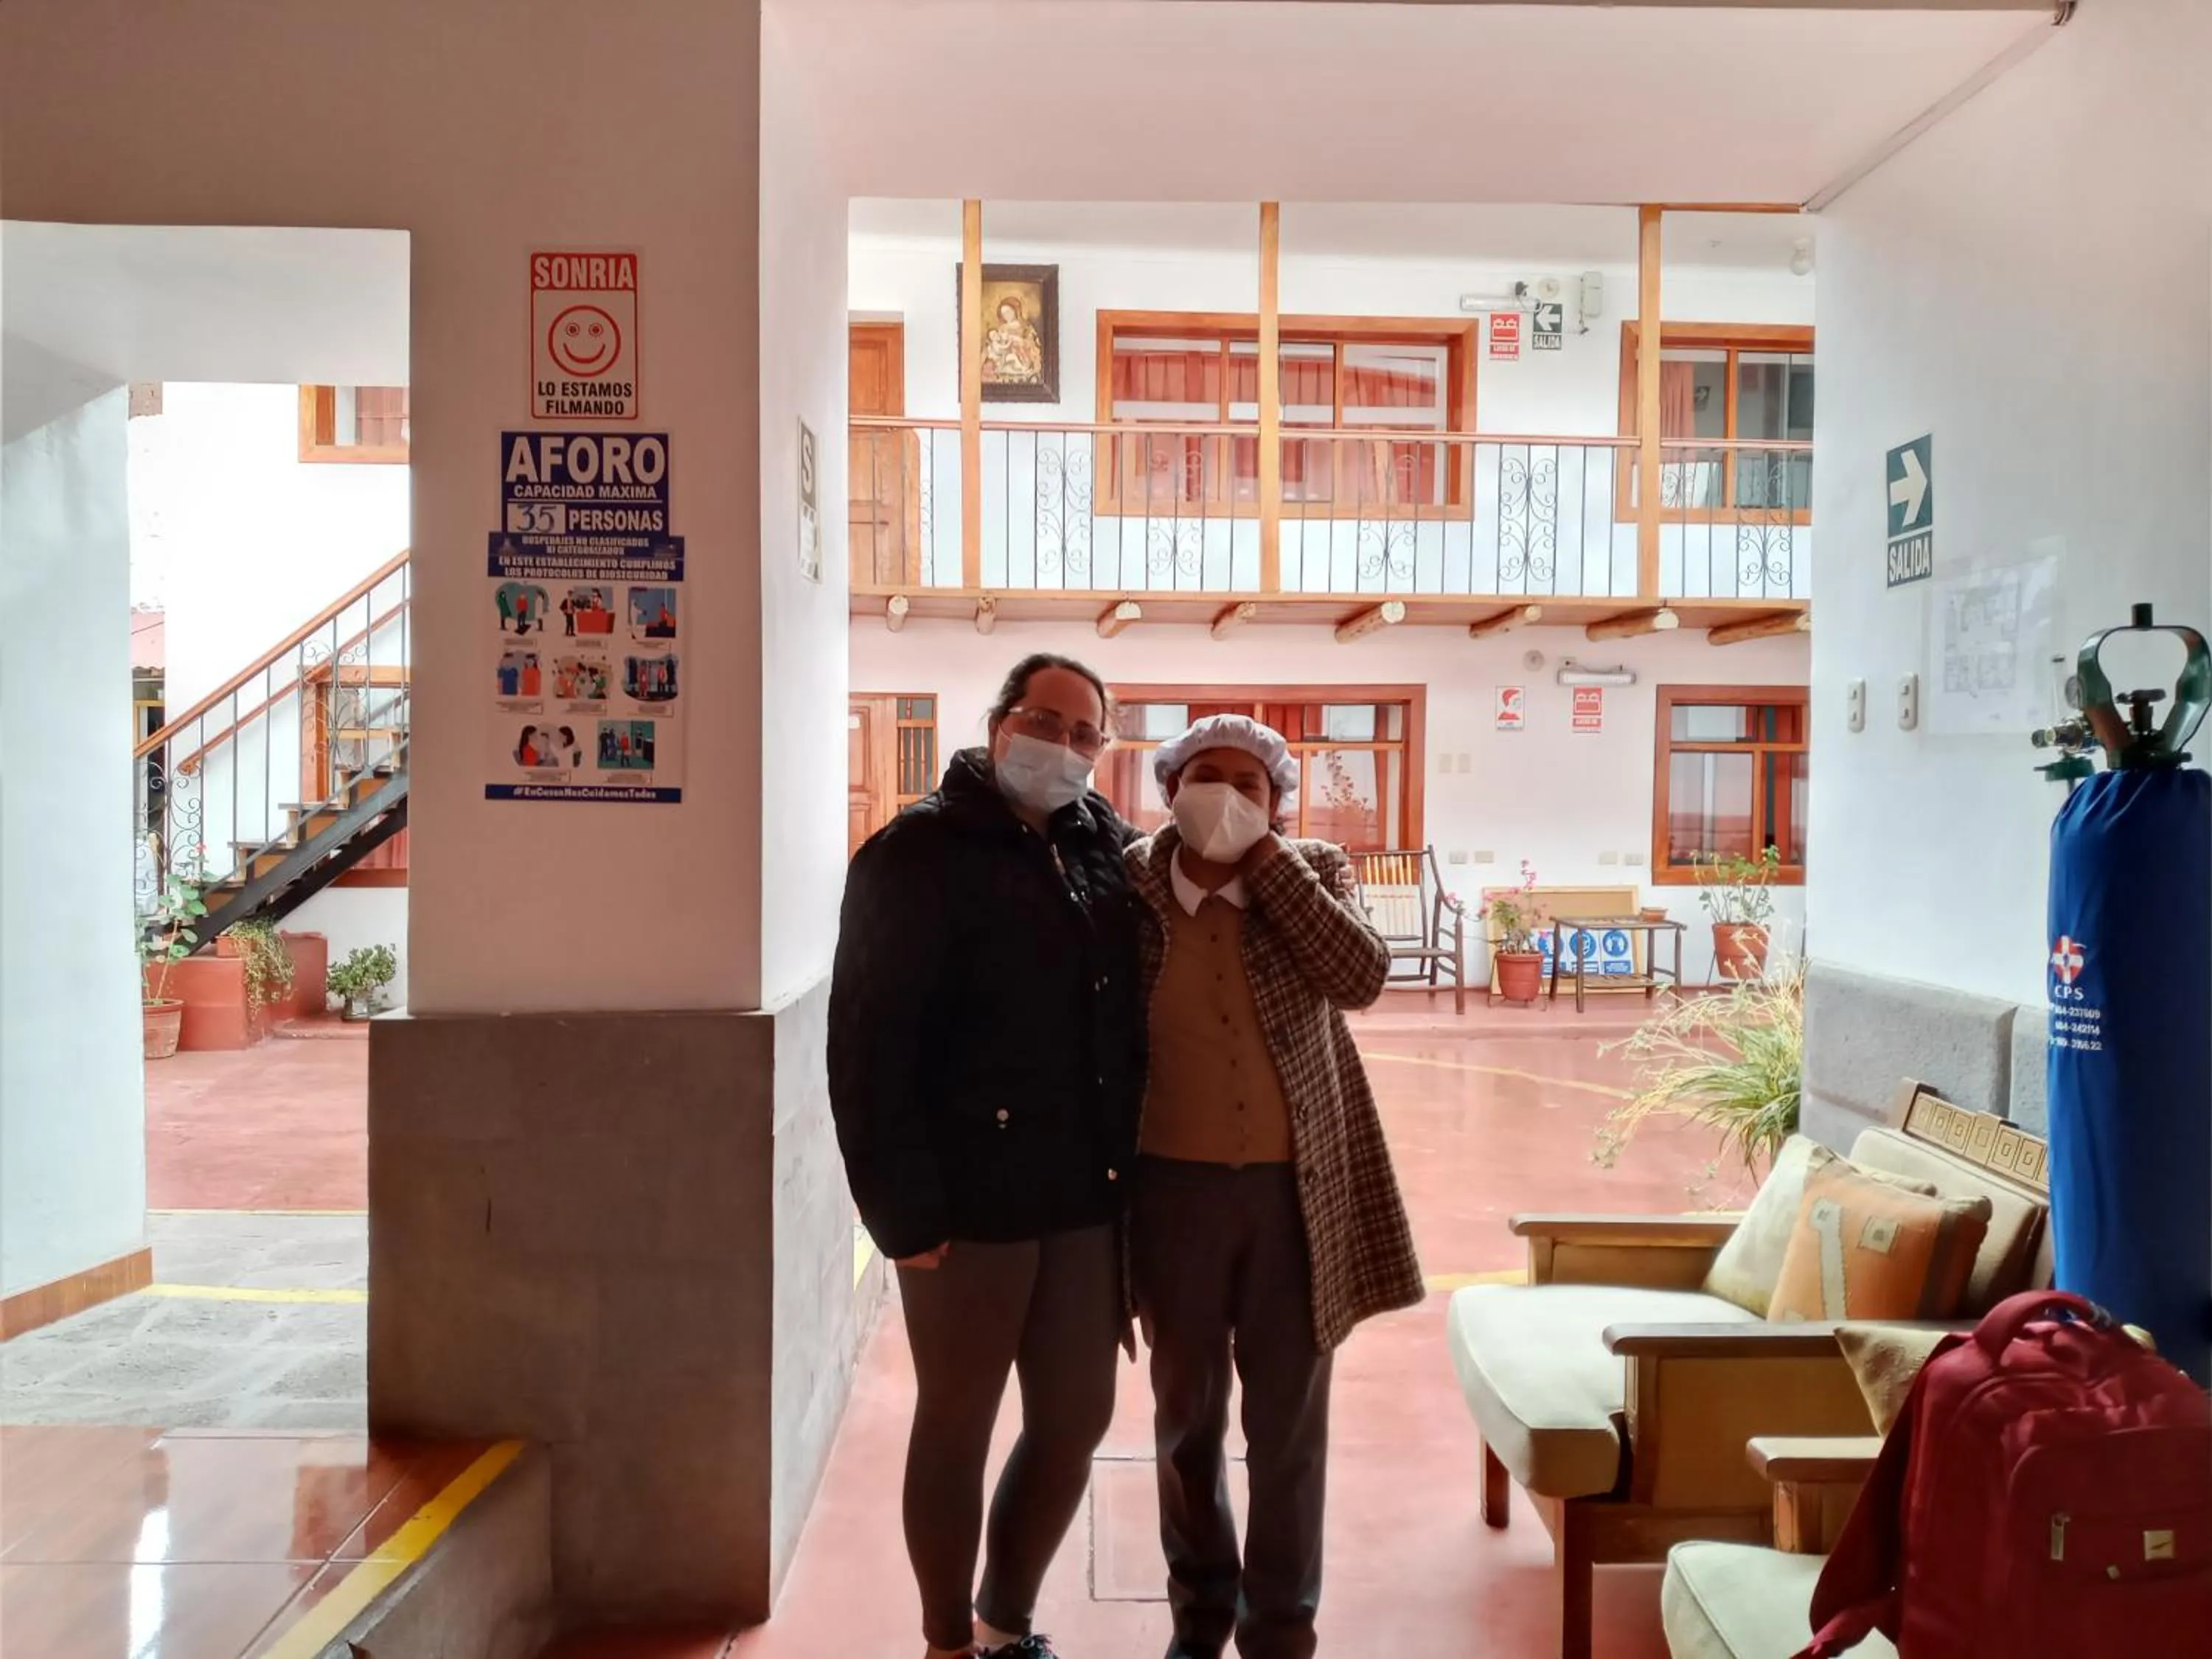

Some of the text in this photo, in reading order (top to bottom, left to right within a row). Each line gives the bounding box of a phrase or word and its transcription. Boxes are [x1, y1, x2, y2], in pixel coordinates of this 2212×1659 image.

[535, 257, 634, 289] SONRIA
[538, 381, 632, 397] LO ESTAMOS
[546, 400, 625, 415] FILMANDO
[506, 436, 666, 484] AFORO
[514, 484, 657, 499] CAPACIDAD MAXIMA
[516, 504, 663, 532] 35 PERSONAS
[1888, 534, 1930, 582] SALIDA
[2054, 984, 2084, 1001] CPS
